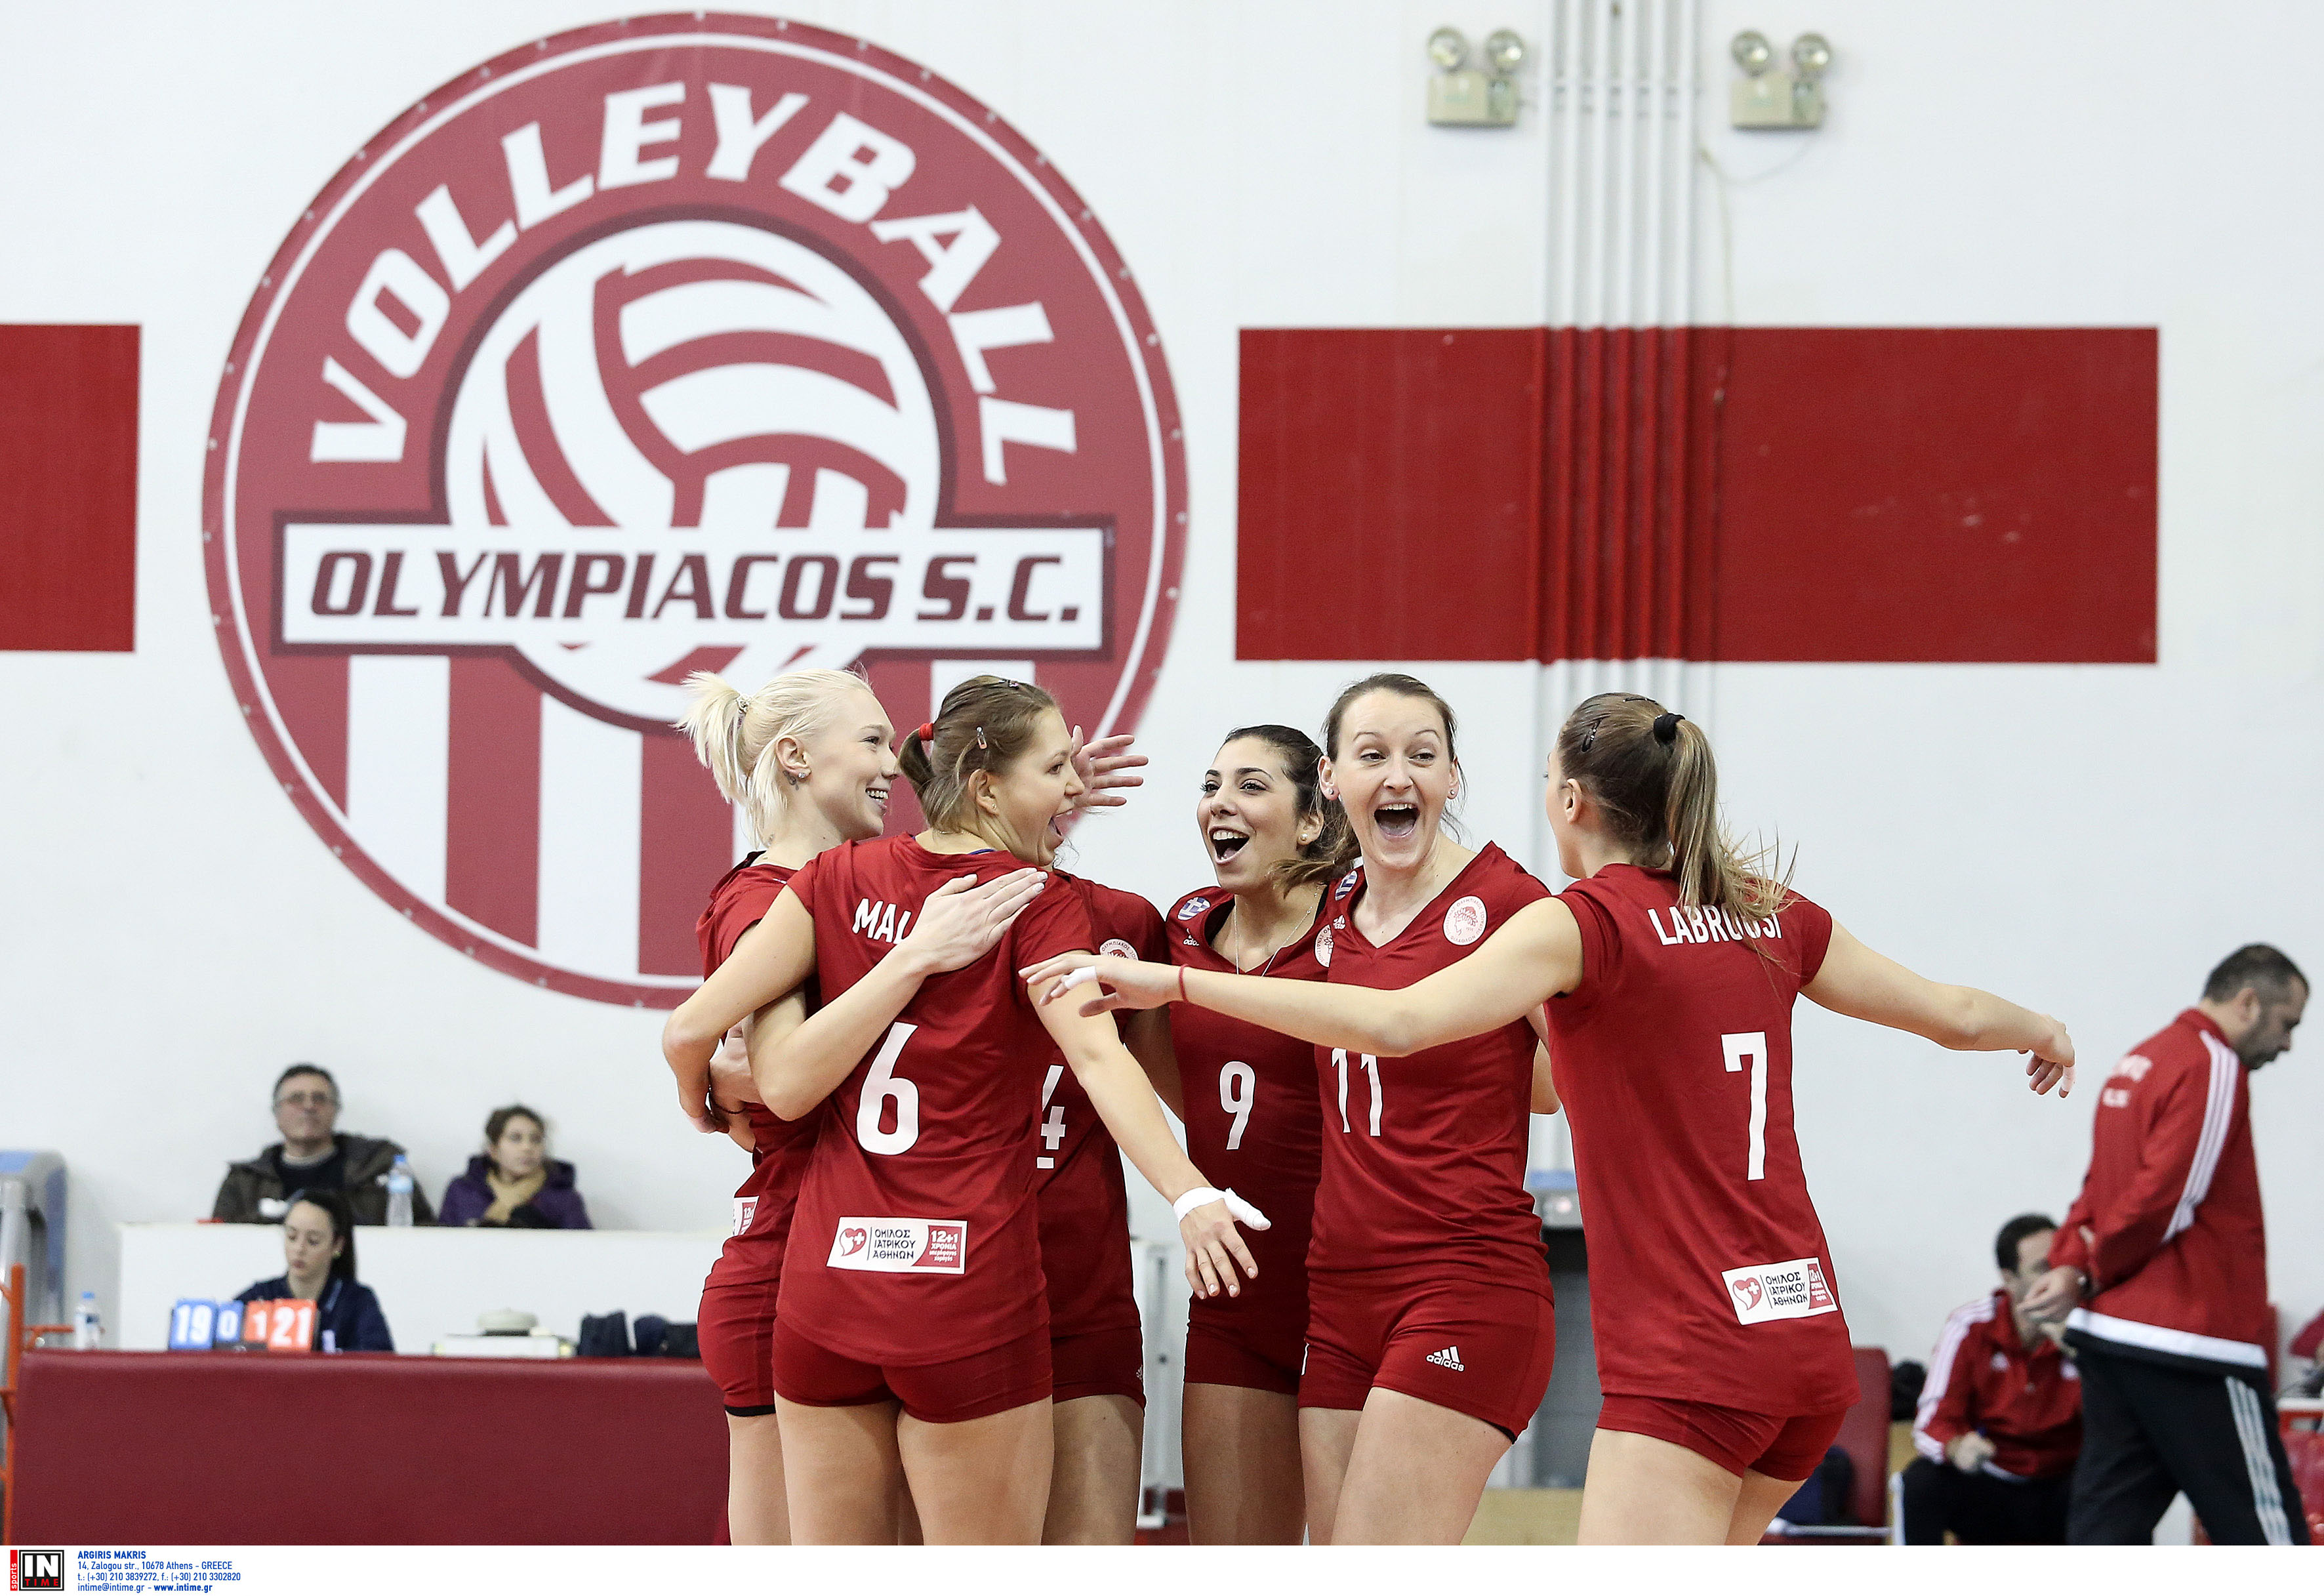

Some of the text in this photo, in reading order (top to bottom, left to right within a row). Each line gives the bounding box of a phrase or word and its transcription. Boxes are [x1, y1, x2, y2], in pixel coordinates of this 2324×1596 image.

[310, 81, 1077, 485] VOLLEYBALL
[312, 551, 1079, 621] OLYMPIACOS S.C.
[857, 1022, 919, 1155] 6
[1332, 1048, 1382, 1136] 11
[1219, 1061, 1255, 1150] 9
[1721, 1031, 1766, 1181] 7
[874, 1239, 916, 1248] ΙΑΤΡΙΚΟΥ
[875, 1229, 910, 1238] ΟΜΙΛΟΣ
[931, 1230, 958, 1243] 12+1
[872, 1250, 914, 1259] ΑΘΗΝΩΝ
[1766, 1271, 1801, 1285] ΟΜΙΛΟΣ
[1769, 1282, 1805, 1296] ΙΑΤΡΙΚΟΥ
[1772, 1293, 1808, 1306] ΑΘΗΝΩΝ
[176, 1304, 213, 1344] 19
[217, 1310, 238, 1339] 0
[253, 1311, 267, 1342] 1
[271, 1306, 314, 1347] 21
[1426, 1354, 1465, 1372] adidas
